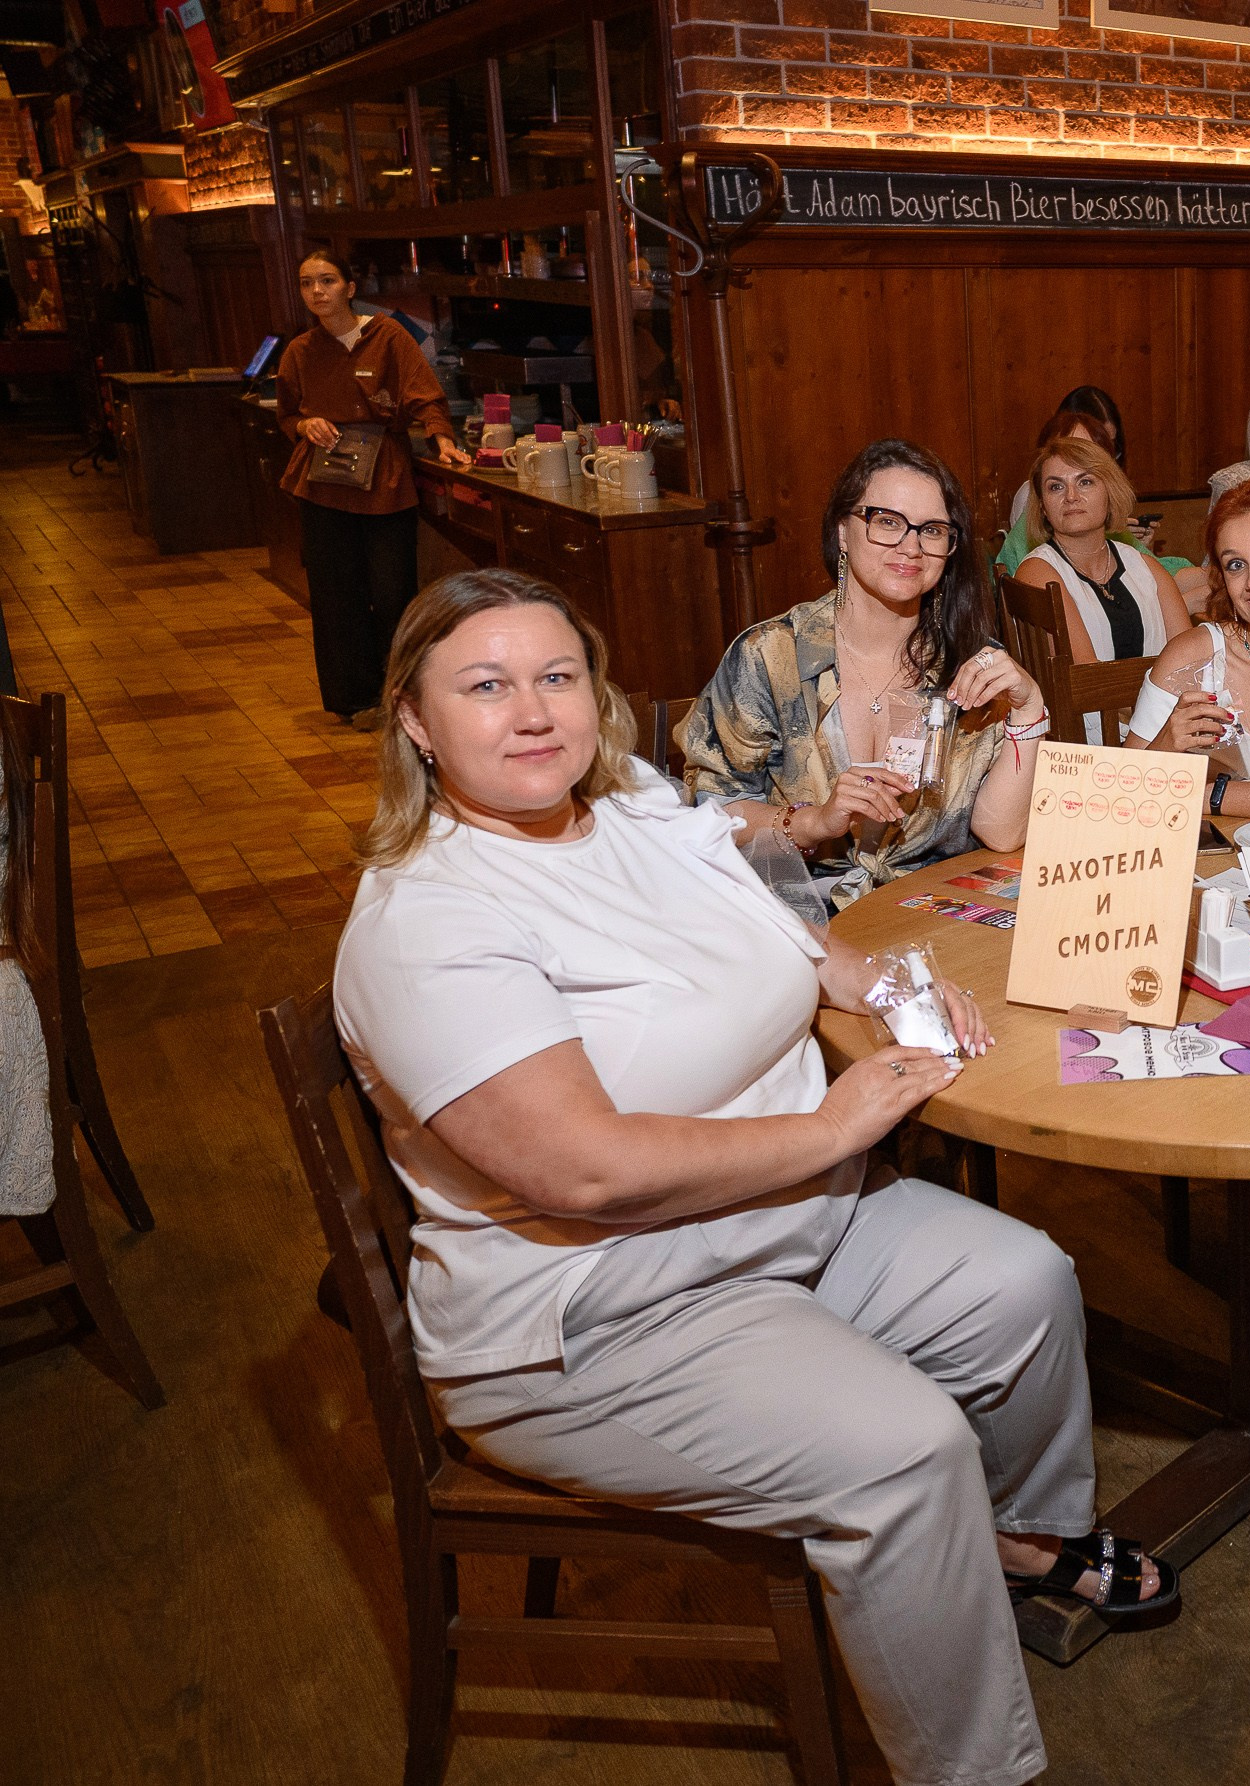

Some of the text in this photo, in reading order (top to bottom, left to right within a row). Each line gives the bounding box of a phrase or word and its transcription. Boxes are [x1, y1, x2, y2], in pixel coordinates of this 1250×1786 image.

[721, 173, 801, 216] Hät
[806, 177, 882, 217] Adam
[888, 176, 1001, 223] bayrisch
[1009, 181, 1067, 223] Bier
[1071, 187, 1169, 222] besessen
[1050, 763, 1078, 777] КВИЗ
[1037, 847, 1164, 888] ЗАХОТЕЛА
[1096, 893, 1111, 916] И
[1058, 923, 1159, 958] СМОГЛА
